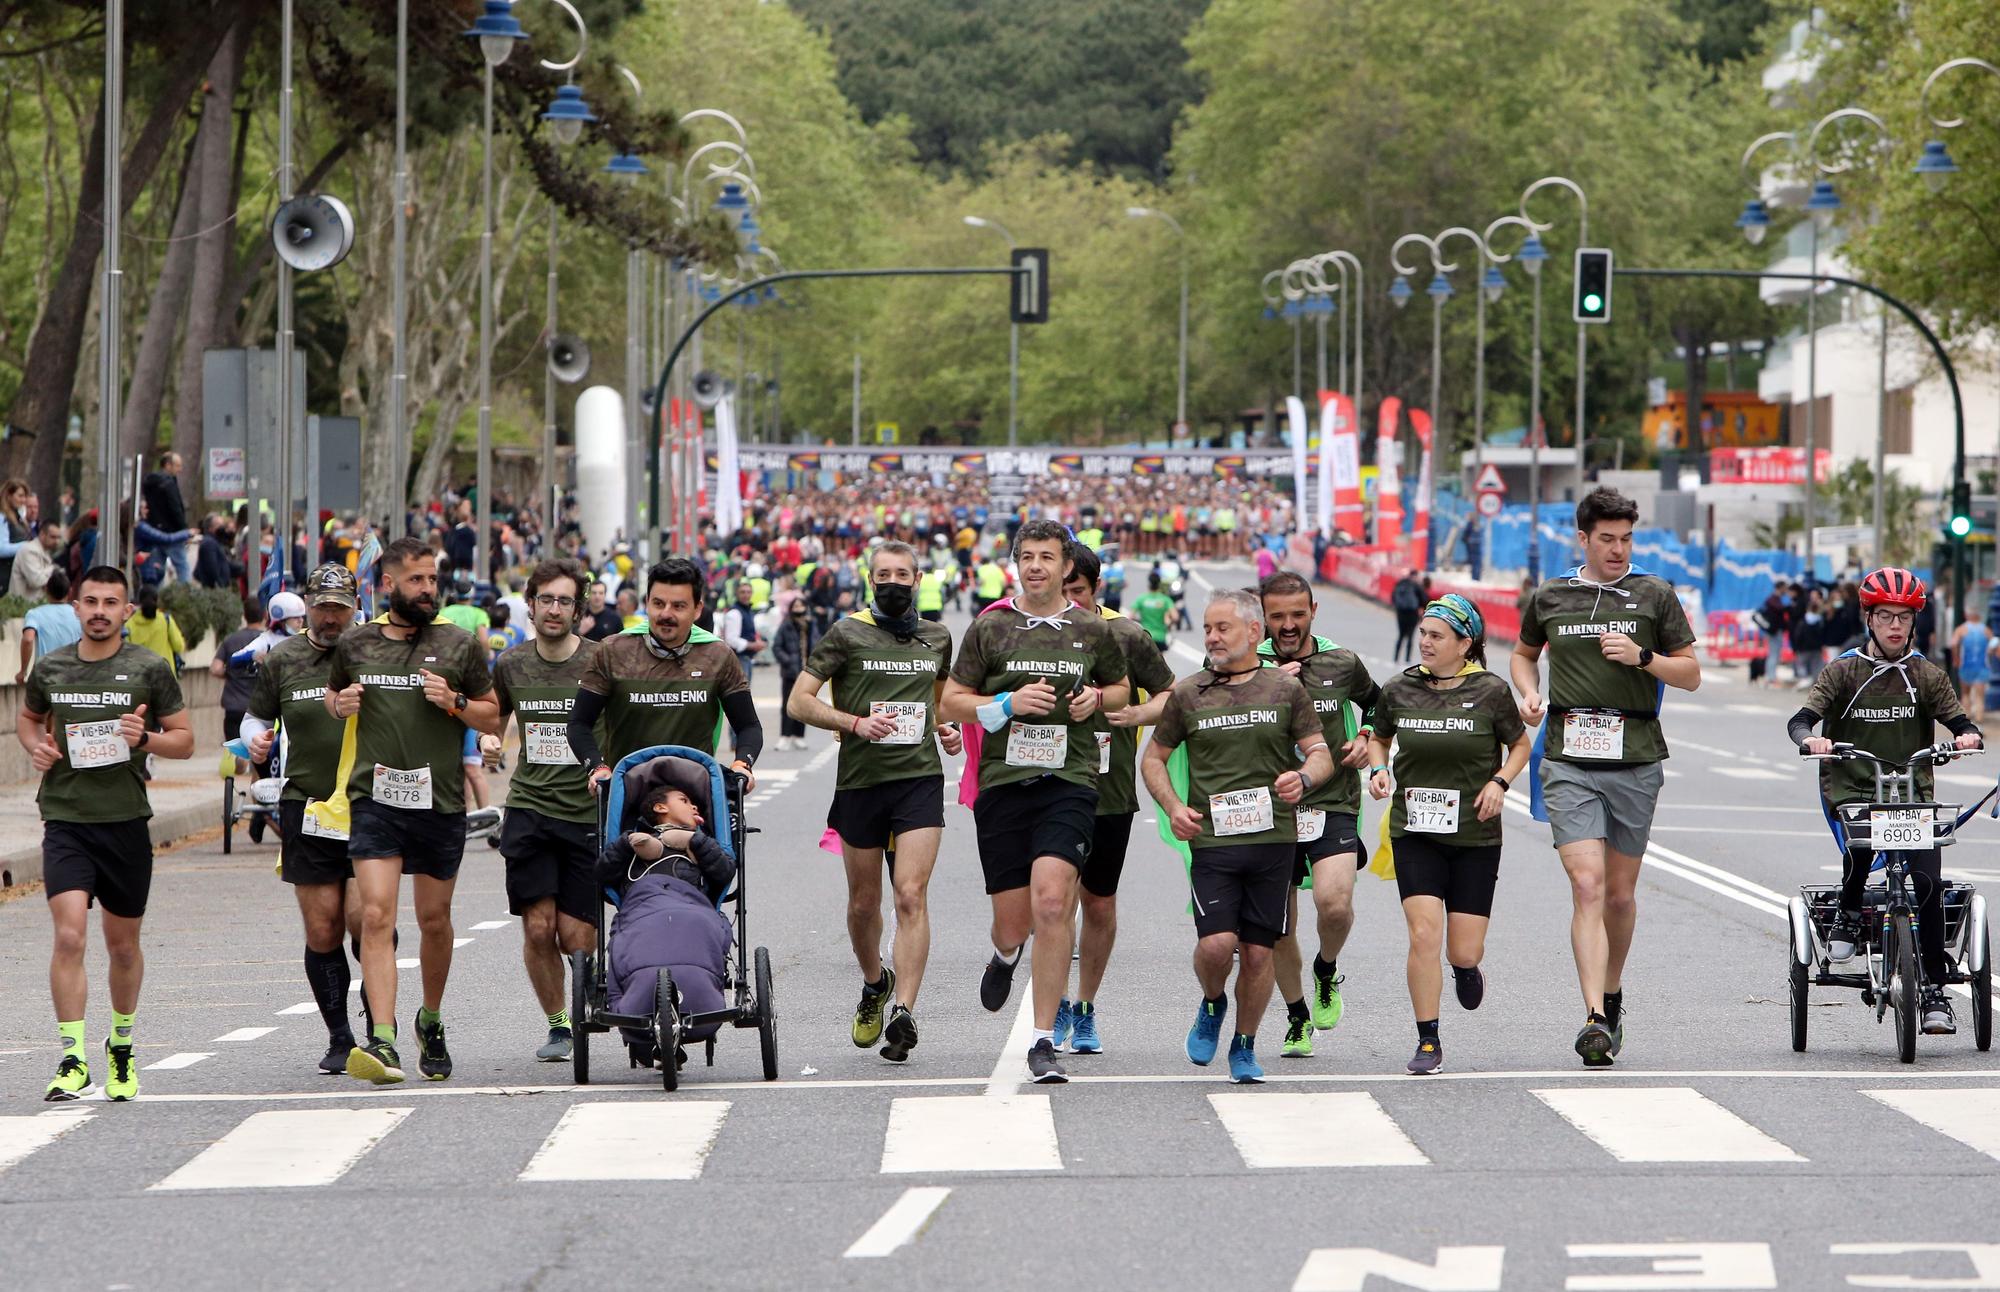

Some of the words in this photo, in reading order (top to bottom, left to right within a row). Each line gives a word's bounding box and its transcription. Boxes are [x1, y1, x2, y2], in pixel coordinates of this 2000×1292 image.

[1557, 624, 1607, 635] MARINES
[1609, 621, 1637, 633] ENKI
[863, 661, 911, 672] MARINES
[913, 659, 936, 673] ENKI
[1006, 661, 1056, 672] MARINES
[1058, 660, 1084, 676] ENKI
[359, 674, 408, 686] MARINES
[409, 674, 424, 687] EN
[50, 693, 101, 704] MARINES
[102, 692, 131, 706] ENKI
[292, 687, 327, 701] MARIN
[629, 692, 679, 703] MARINES
[681, 690, 707, 703] ENKI
[519, 700, 563, 711] MARINES
[1314, 699, 1337, 712] ENKI
[1892, 706, 1915, 719] ENKI
[1198, 713, 1249, 730] MARINES
[1250, 710, 1277, 723] ENKI
[1398, 718, 1444, 729] MARINES
[1445, 717, 1473, 731] ENKI
[1573, 736, 1611, 751] 4855
[79, 744, 118, 760] 4848
[536, 744, 569, 758] 4851
[1017, 746, 1055, 761] 5429
[384, 788, 420, 802] 6178
[1224, 811, 1264, 827] 4844
[1412, 811, 1446, 825] 6177
[1883, 829, 1922, 843] 6903
